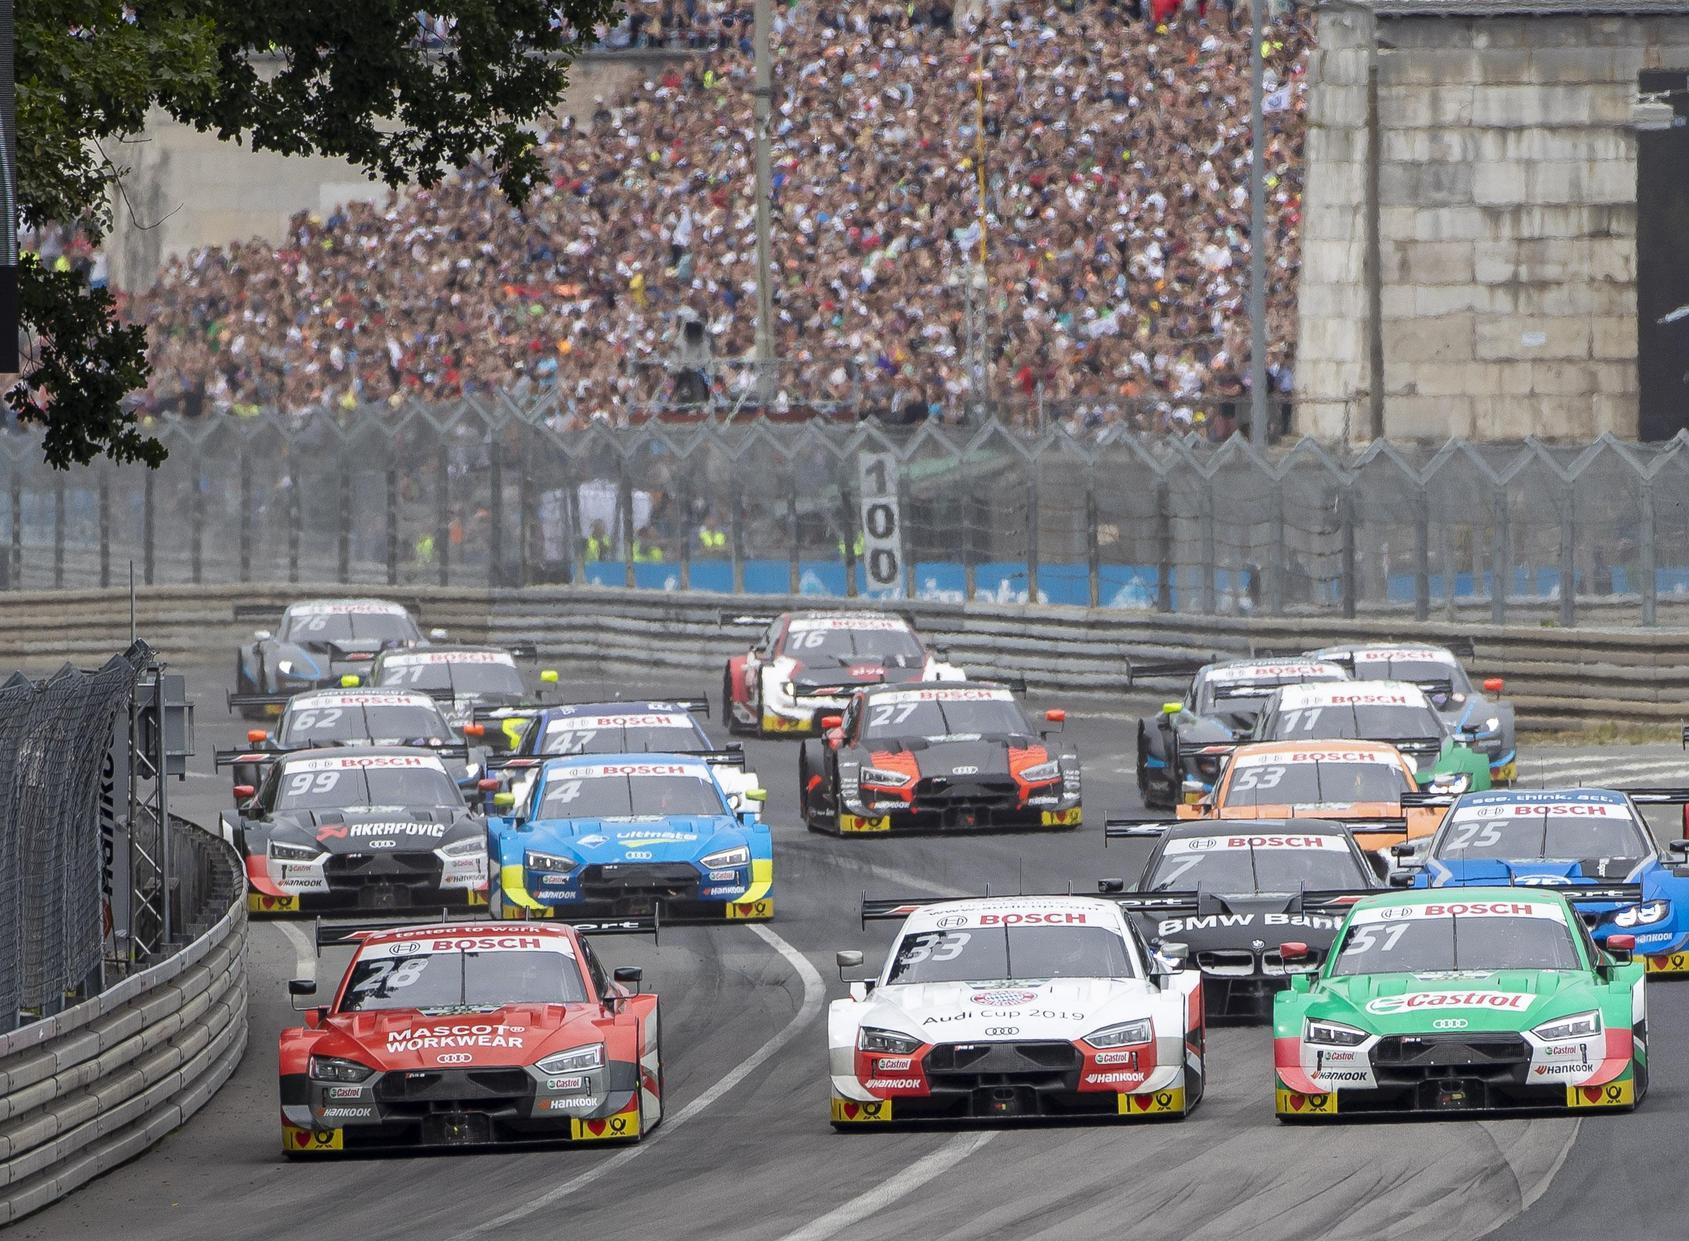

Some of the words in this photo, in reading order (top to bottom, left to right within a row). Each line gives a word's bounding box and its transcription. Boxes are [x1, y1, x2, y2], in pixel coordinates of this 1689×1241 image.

[865, 459, 898, 584] 100
[293, 615, 328, 632] 76
[792, 630, 828, 650] 16
[430, 652, 495, 662] BOSCH
[1366, 652, 1433, 660] BOSCH
[1255, 666, 1324, 675] BOSCH
[341, 695, 411, 704] BOSCH
[920, 690, 992, 700] BOSCH
[1331, 695, 1406, 704] BOSCH
[292, 709, 343, 730] 62
[597, 715, 671, 726] BOSCH
[870, 702, 919, 727] 27
[1282, 709, 1322, 734] 11
[547, 730, 597, 753] 47
[340, 757, 421, 768] BOSCH
[1292, 752, 1375, 762] BOSCH
[603, 765, 685, 775] BOSCH
[288, 771, 340, 795] 99
[1232, 766, 1287, 792] 53
[547, 779, 583, 804] 4
[1472, 796, 1511, 805] see.
[1516, 793, 1571, 801] think.
[1577, 794, 1614, 803] act.
[1515, 805, 1607, 816] BOSCH
[1227, 837, 1323, 848] BOSCH
[1446, 821, 1509, 851] 25
[1151, 854, 1205, 892] 7
[1424, 903, 1533, 915] BOSCH
[979, 913, 1087, 925] BOSCH
[1157, 913, 1255, 937] BMW
[395, 926, 458, 939] tested
[466, 926, 484, 934] to
[486, 924, 540, 935] work
[431, 937, 541, 951] BOSCH
[1343, 923, 1410, 955] 51
[901, 932, 971, 965] 33
[353, 958, 430, 992] 28
[1406, 992, 1522, 1008] Castrol
[922, 1010, 974, 1026] Audi
[980, 1008, 1021, 1019] Cup
[1028, 1008, 1086, 1021] 2019
[386, 1035, 524, 1054] WORKWEAR
[1553, 1046, 1577, 1055] Castrol
[1103, 1052, 1128, 1063] Castrol
[1331, 1052, 1355, 1061] Castrol
[885, 1059, 909, 1070] Castrol
[555, 1077, 580, 1088] Castrol
[336, 1087, 361, 1098] Castrol
